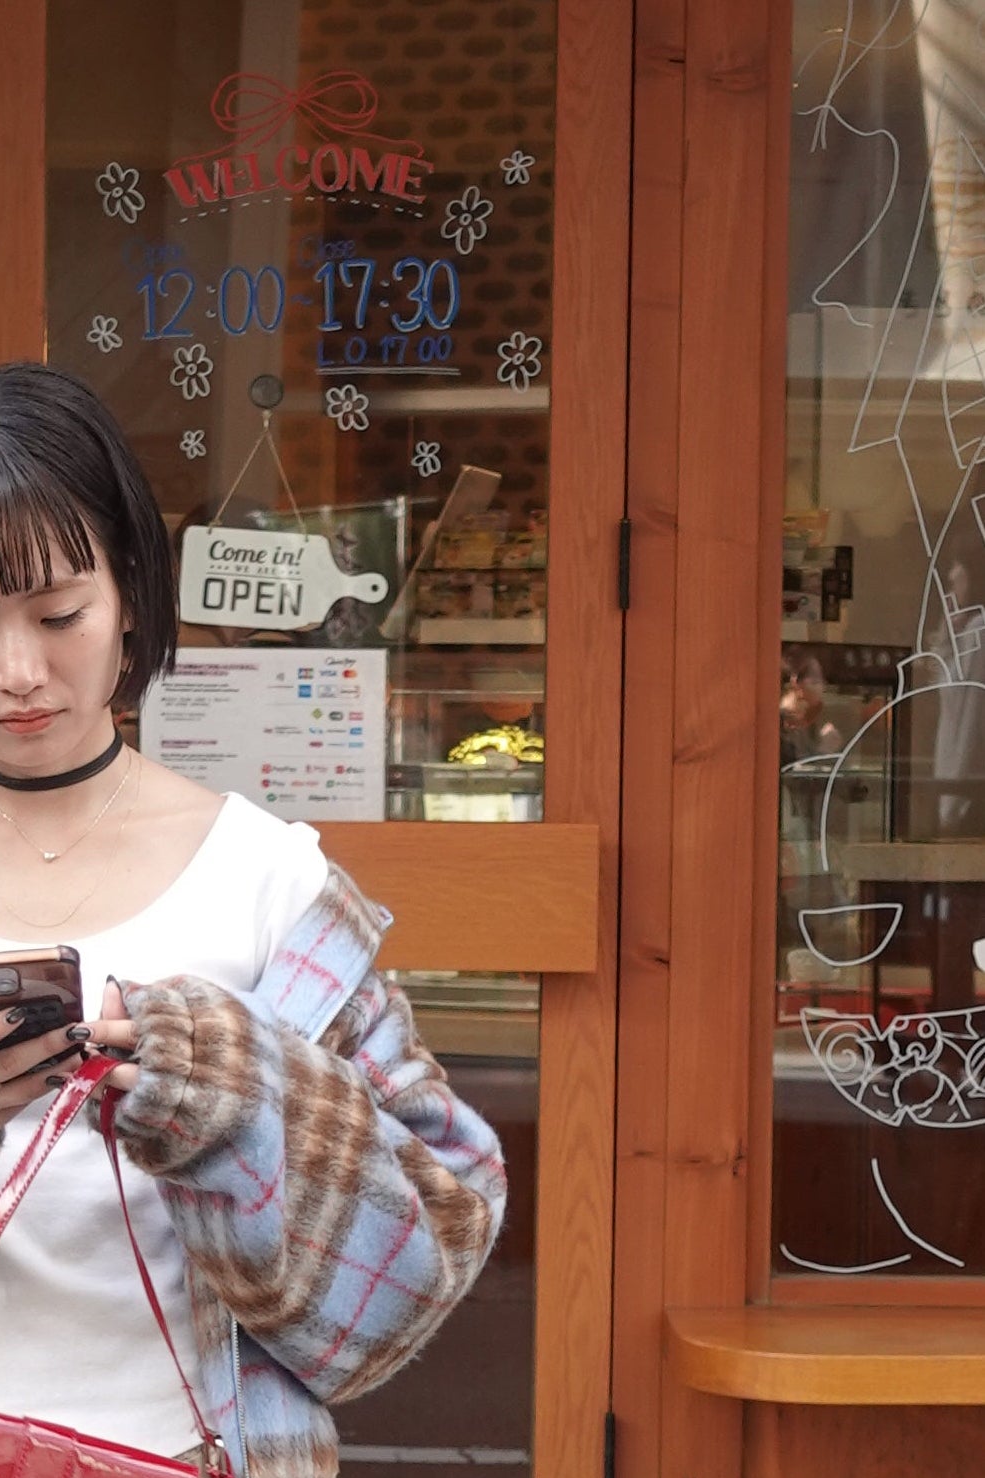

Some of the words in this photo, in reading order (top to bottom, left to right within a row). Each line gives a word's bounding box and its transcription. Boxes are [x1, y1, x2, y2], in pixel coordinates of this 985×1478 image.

[164, 144, 434, 206] WELCOME
[136, 264, 286, 341] 12:00
[315, 256, 460, 333] 17:30
[209, 540, 267, 563] Come
[273, 546, 304, 566] in!
[203, 578, 303, 616] OPEN
